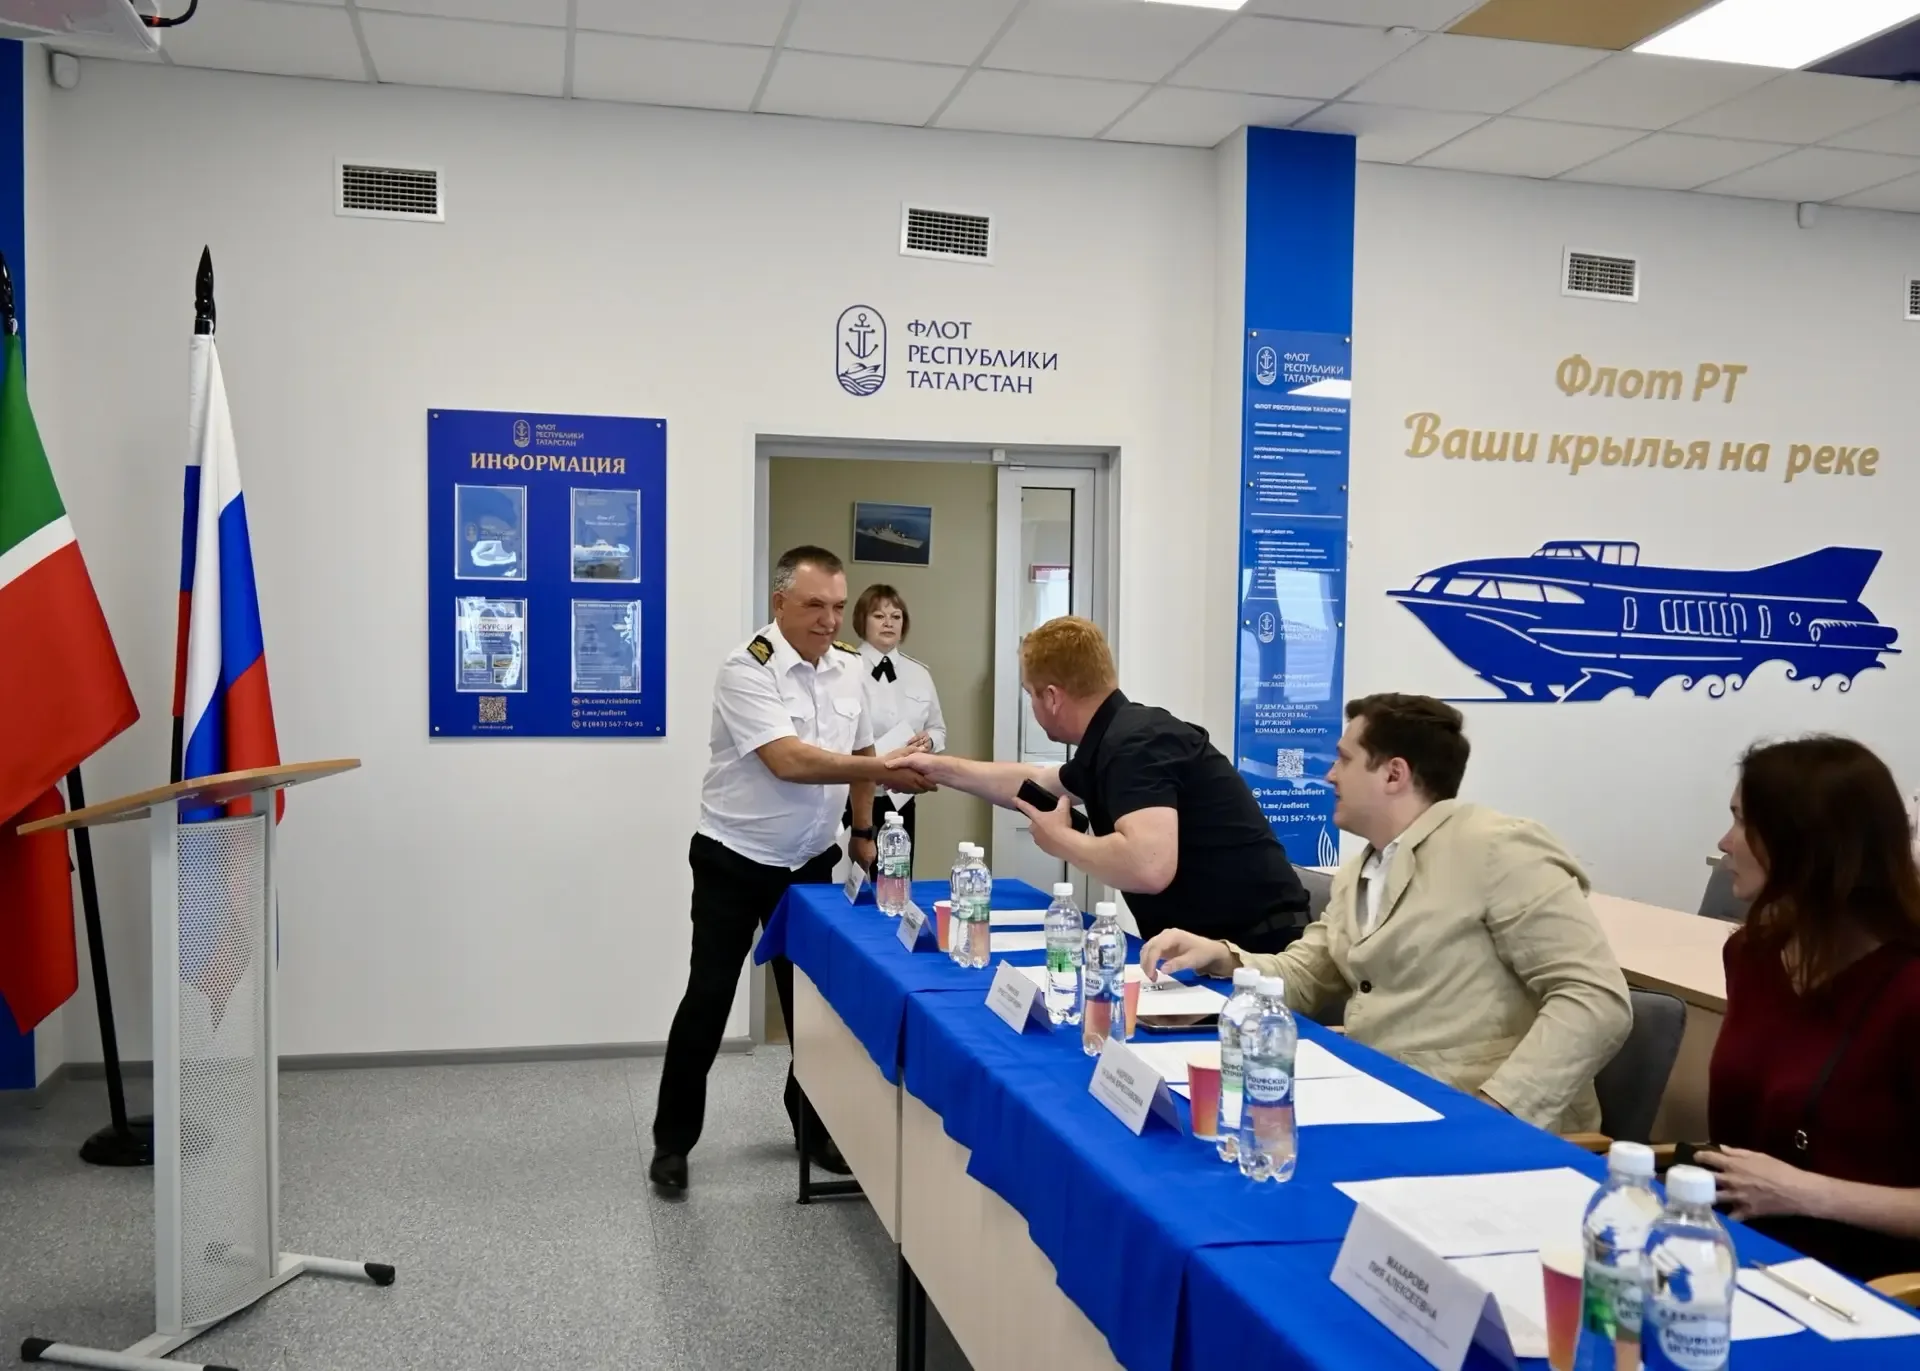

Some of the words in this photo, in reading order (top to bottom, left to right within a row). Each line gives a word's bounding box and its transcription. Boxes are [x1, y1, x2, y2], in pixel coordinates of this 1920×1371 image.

[907, 319, 972, 340] ФЛОТ
[908, 344, 1058, 371] РЕСПУБЛИКИ
[1284, 352, 1310, 363] ФЛОТ
[1284, 363, 1344, 375] РЕСПУБЛИКИ
[907, 370, 1032, 394] ТАТАРСТАН
[1555, 353, 1684, 397] Флот
[1691, 362, 1748, 403] РТ
[1272, 404, 1312, 412] РЕСПУБЛИКИ
[1312, 406, 1347, 414] ТАТАРСТАН
[535, 430, 585, 440] РЕСПУБЛИКИ
[535, 438, 577, 447] ТАТАРСТАН
[1403, 411, 1539, 463] Ваши
[1546, 432, 1711, 476] крылья
[1718, 440, 1770, 473] на
[1783, 441, 1880, 483] реке
[470, 452, 626, 476] ИНФОРМАЦИЯ
[608, 720, 644, 728] 567-76-93
[1290, 814, 1327, 822] 567-76-93
[1386, 1254, 1430, 1295] МАКАРОВА
